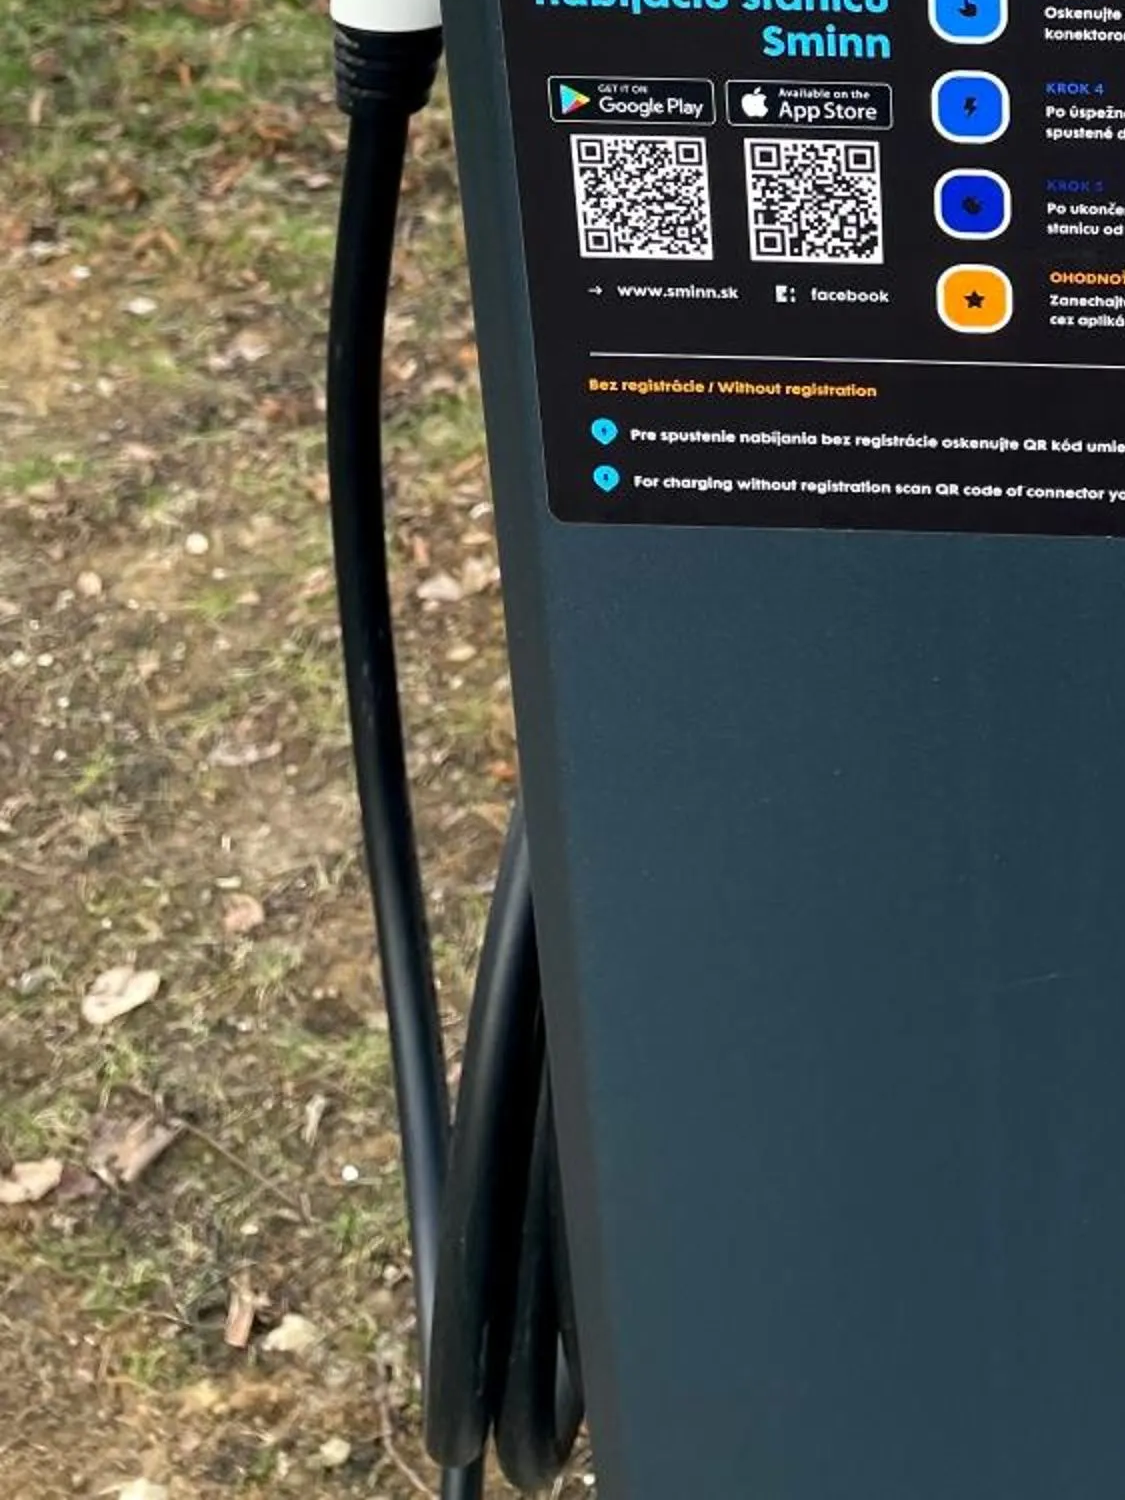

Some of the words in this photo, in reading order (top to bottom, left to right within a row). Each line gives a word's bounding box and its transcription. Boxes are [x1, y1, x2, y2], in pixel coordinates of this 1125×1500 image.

[1043, 5, 1123, 24] Oskenujte
[762, 24, 891, 60] Sminn
[777, 87, 832, 100] Available
[832, 90, 850, 100] on
[850, 89, 871, 100] the
[1045, 81, 1090, 95] KROK
[1093, 83, 1105, 96] 4
[598, 95, 665, 119] Google
[666, 96, 705, 119] Play
[778, 100, 822, 124] App
[823, 100, 878, 121] Store
[616, 283, 739, 300] www.sminn.sk
[810, 287, 890, 303] facebook
[588, 377, 620, 392] Bez
[716, 380, 783, 396] Without
[784, 382, 878, 399] registration
[633, 474, 660, 488] For
[662, 476, 734, 493] charging
[736, 477, 798, 492] without
[800, 479, 892, 496] registration
[894, 483, 933, 496] scan
[934, 482, 960, 496] QR
[962, 484, 1004, 498] code
[1005, 484, 1024, 498] of
[1025, 486, 1106, 500] connector
